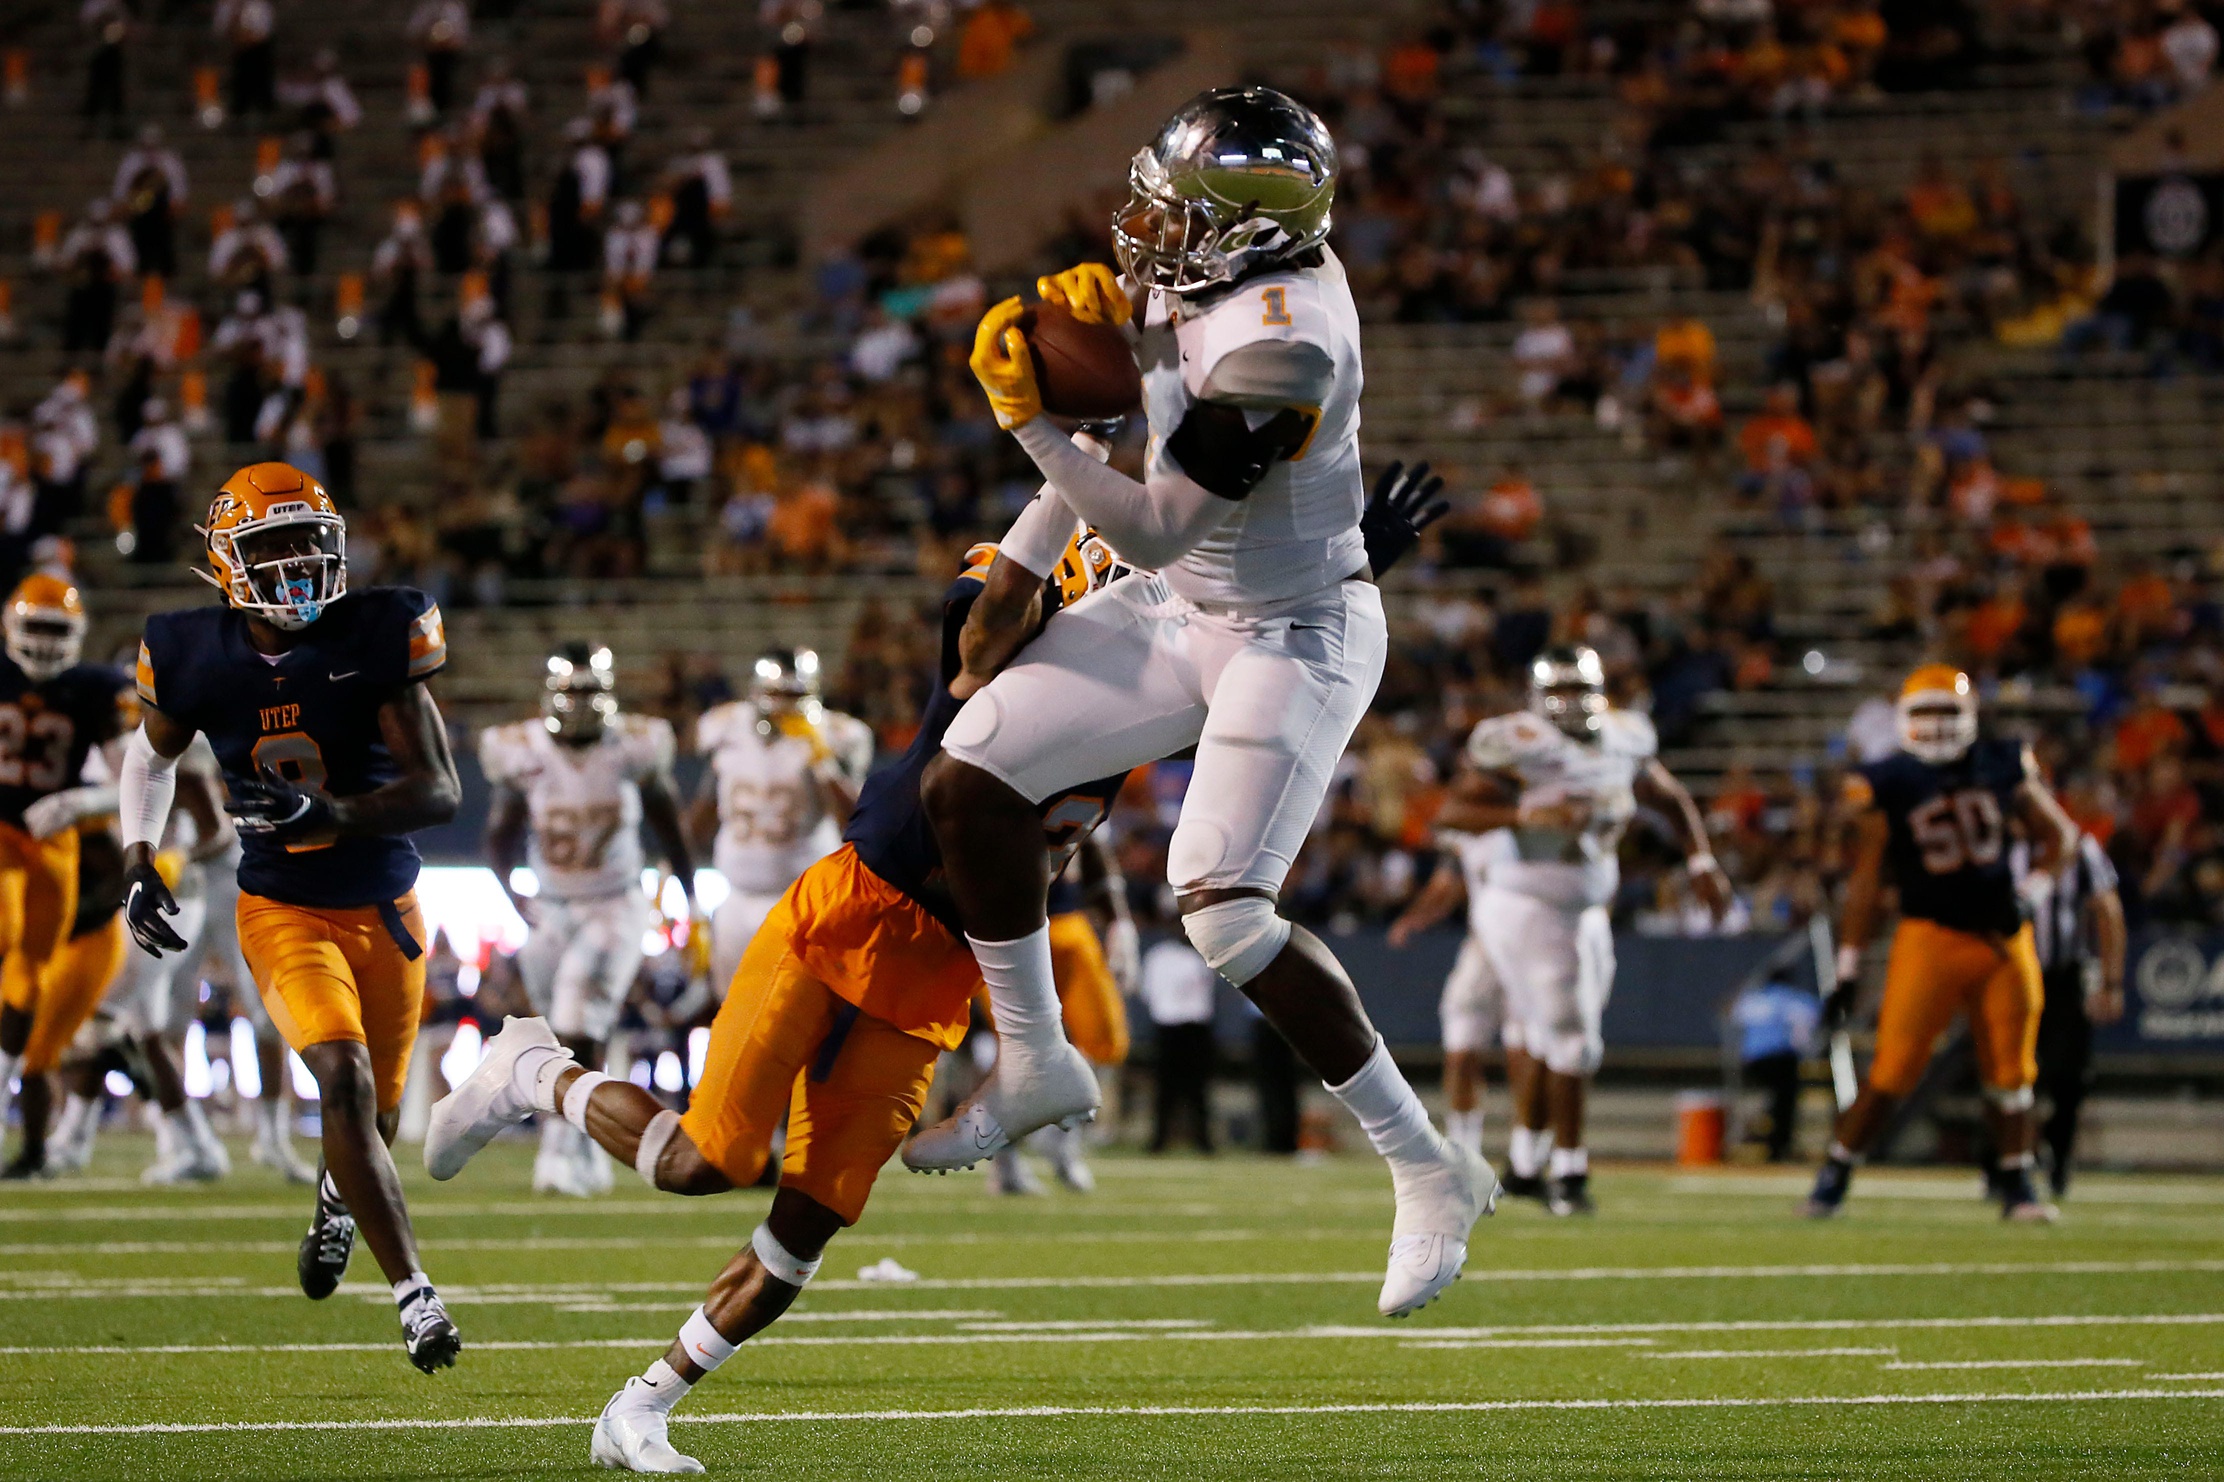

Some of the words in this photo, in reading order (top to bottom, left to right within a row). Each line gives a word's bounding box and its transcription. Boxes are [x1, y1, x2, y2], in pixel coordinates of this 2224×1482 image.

[1261, 286, 1292, 326] 1
[273, 503, 304, 514] UTEP
[259, 703, 300, 731] UTEP
[1908, 788, 2003, 876] 50
